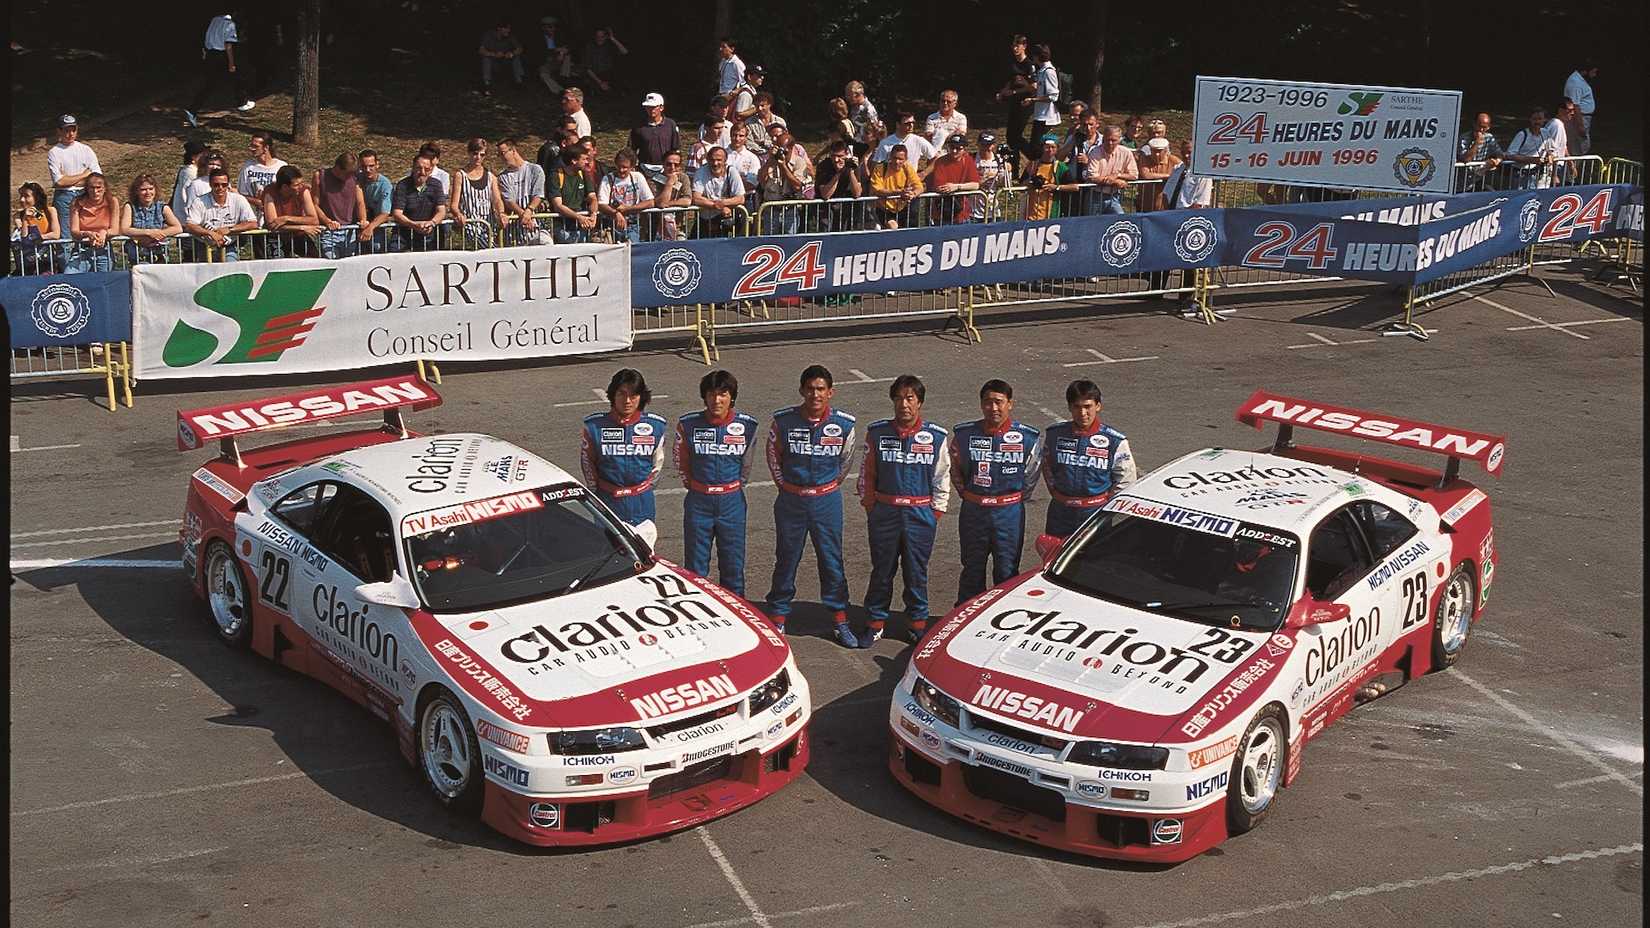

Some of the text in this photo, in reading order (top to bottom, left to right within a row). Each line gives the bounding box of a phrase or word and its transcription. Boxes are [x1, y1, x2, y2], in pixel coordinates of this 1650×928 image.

[1218, 85, 1328, 108] 1923-1996
[1207, 111, 1438, 144] 24 HEURES DU MANS
[1211, 153, 1231, 168] 15
[1248, 152, 1268, 167] 16
[1278, 151, 1322, 167] JUIN
[1332, 149, 1378, 165] 1996
[1538, 188, 1613, 242] 24
[1241, 220, 1337, 270] 24
[1435, 231, 1460, 263] DU
[731, 240, 826, 300] 24
[832, 244, 933, 287] HEURES
[940, 237, 979, 271] DU
[983, 224, 1061, 264] MANS
[366, 254, 600, 312] SARTHE
[367, 314, 600, 358] Conseil Général
[192, 381, 428, 436] NISSAN
[1251, 399, 1490, 456] NISSAN
[601, 444, 655, 456] NISSAN
[694, 443, 747, 456] NISSAN
[789, 443, 842, 456] NISSAN
[882, 450, 935, 465] NISSAN
[970, 449, 1024, 464] NISSAN
[1057, 452, 1109, 470] NISSAN
[405, 439, 465, 494] Clarion
[1163, 464, 1329, 490] Clarion
[405, 508, 468, 534] TV Asahi
[467, 492, 542, 522] NISMO
[1110, 499, 1162, 519] TV Asahi
[1160, 506, 1234, 535] NISMO
[257, 521, 329, 572] NISSAN NISMO
[261, 550, 290, 611] 22
[1367, 540, 1431, 591] NISMO NISSAN
[636, 573, 702, 599] 22
[1402, 571, 1428, 630] 23
[313, 583, 399, 672] Clarion
[499, 598, 721, 664] Clarion
[527, 658, 566, 676] CAR
[574, 640, 631, 663] AUDIO
[664, 619, 733, 639] BEYOND
[990, 608, 1210, 684] Clarion
[1187, 627, 1255, 664] 23
[1305, 606, 1380, 687] Clarion
[975, 630, 1010, 642] CAR
[1018, 639, 1077, 662] AUDIO
[1111, 663, 1188, 695] BEYOND
[630, 673, 739, 720] NISSAN
[770, 691, 799, 716] ICHIKOH
[971, 684, 1085, 733] NISSAN
[903, 700, 937, 727] ICHIKOH
[487, 724, 530, 754] UNIVANCE
[677, 722, 725, 743] Clarion
[987, 733, 1036, 755] Clarion
[563, 755, 615, 766] ICHIKOH
[681, 740, 736, 764] BRIDGESTONE
[975, 751, 1033, 777] BRIDGESTONE
[484, 753, 530, 788] NISMO
[610, 769, 636, 779] NISMO
[1098, 769, 1152, 782] ICHIKOH
[1078, 782, 1105, 794] NISMO
[1185, 770, 1229, 802] NISMO
[1157, 825, 1181, 835] Castrol
